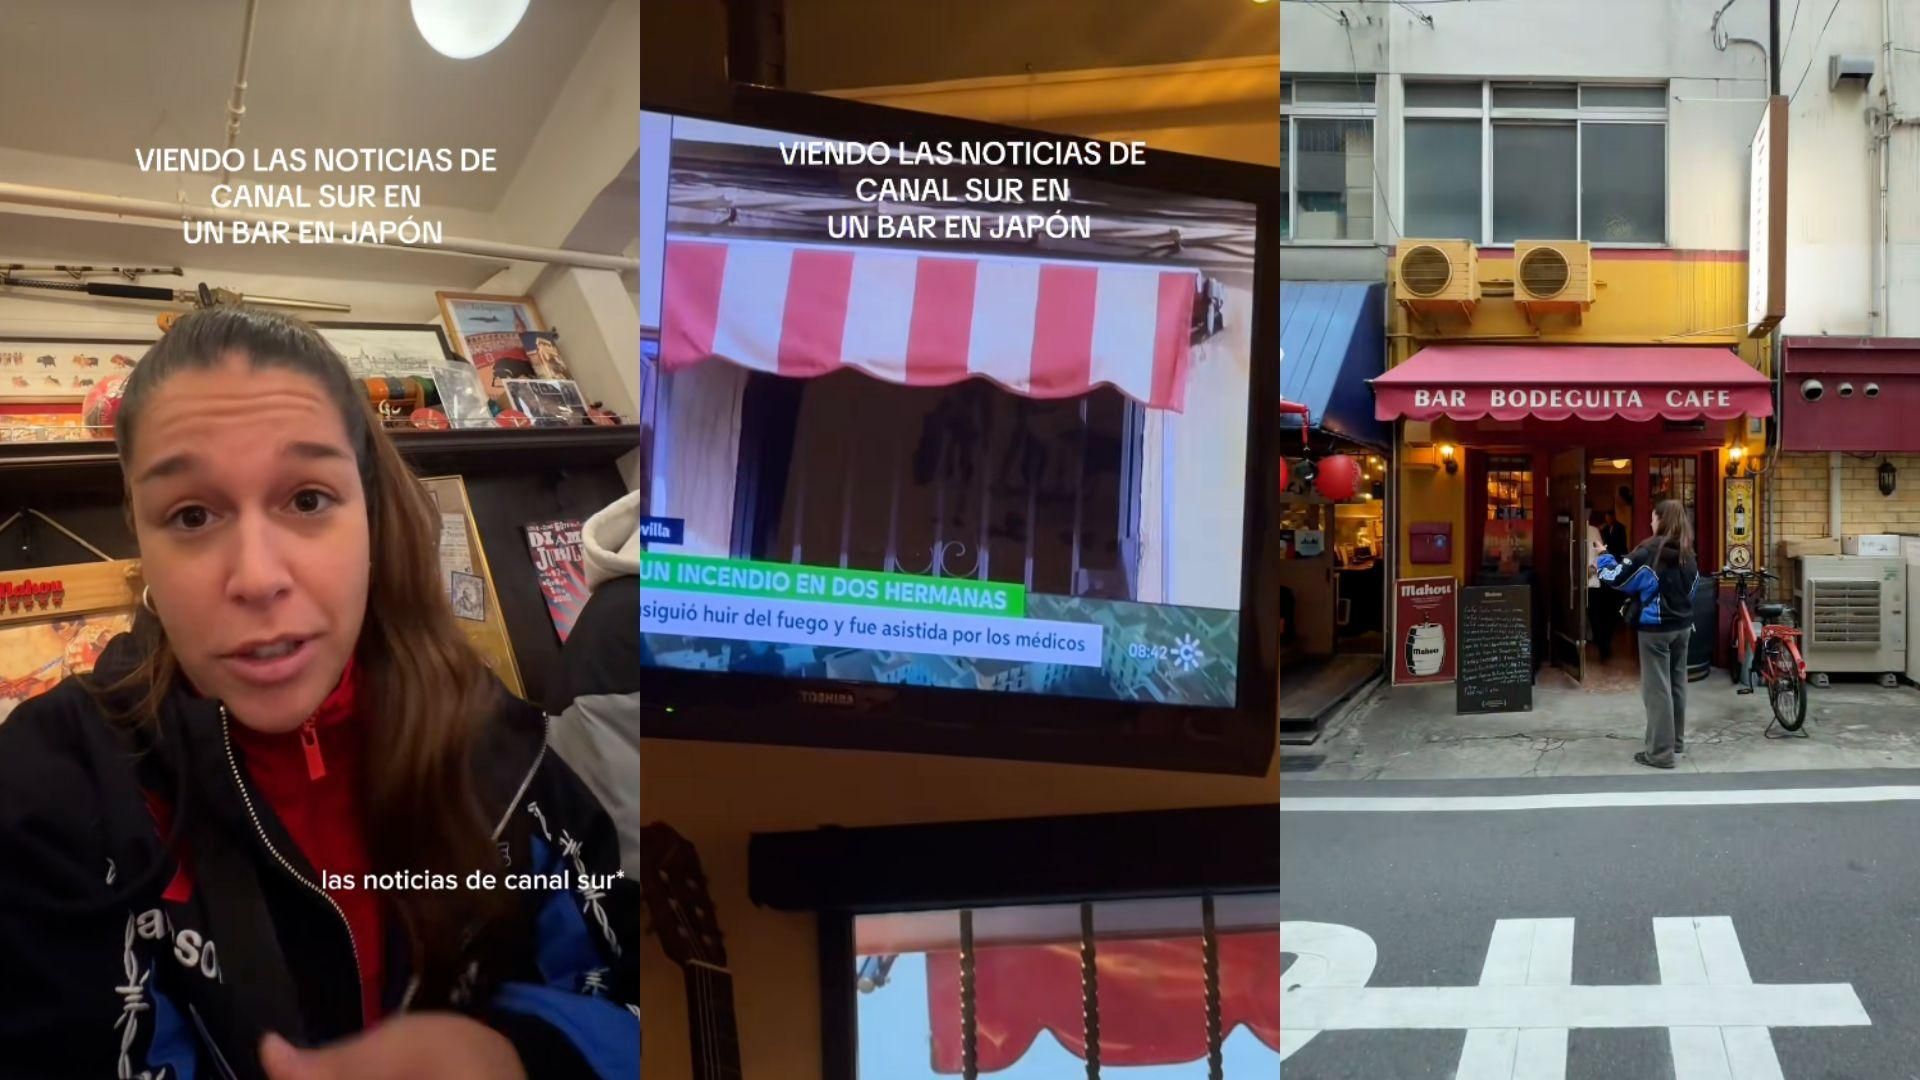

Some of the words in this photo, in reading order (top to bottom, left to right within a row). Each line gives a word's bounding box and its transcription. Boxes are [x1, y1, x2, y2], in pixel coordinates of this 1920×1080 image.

[1414, 390, 1466, 407] BAR
[1491, 389, 1643, 408] BODEGUITA
[1666, 390, 1731, 408] CAFE
[640, 560, 670, 582] UN
[677, 563, 790, 592] INCENDIO
[796, 573, 826, 595] EN
[832, 576, 879, 599] DOS
[885, 580, 1007, 610] HERMANAS
[1401, 584, 1452, 597] Mahou
[703, 605, 739, 625] huir
[744, 609, 771, 627] del
[777, 611, 828, 635] fuego
[834, 619, 844, 636] y
[850, 616, 877, 636] fue
[882, 620, 947, 641] asistida
[953, 629, 981, 645] por
[986, 631, 1010, 645] los
[1015, 632, 1086, 652] médicos
[1128, 642, 1168, 660] 08:42
